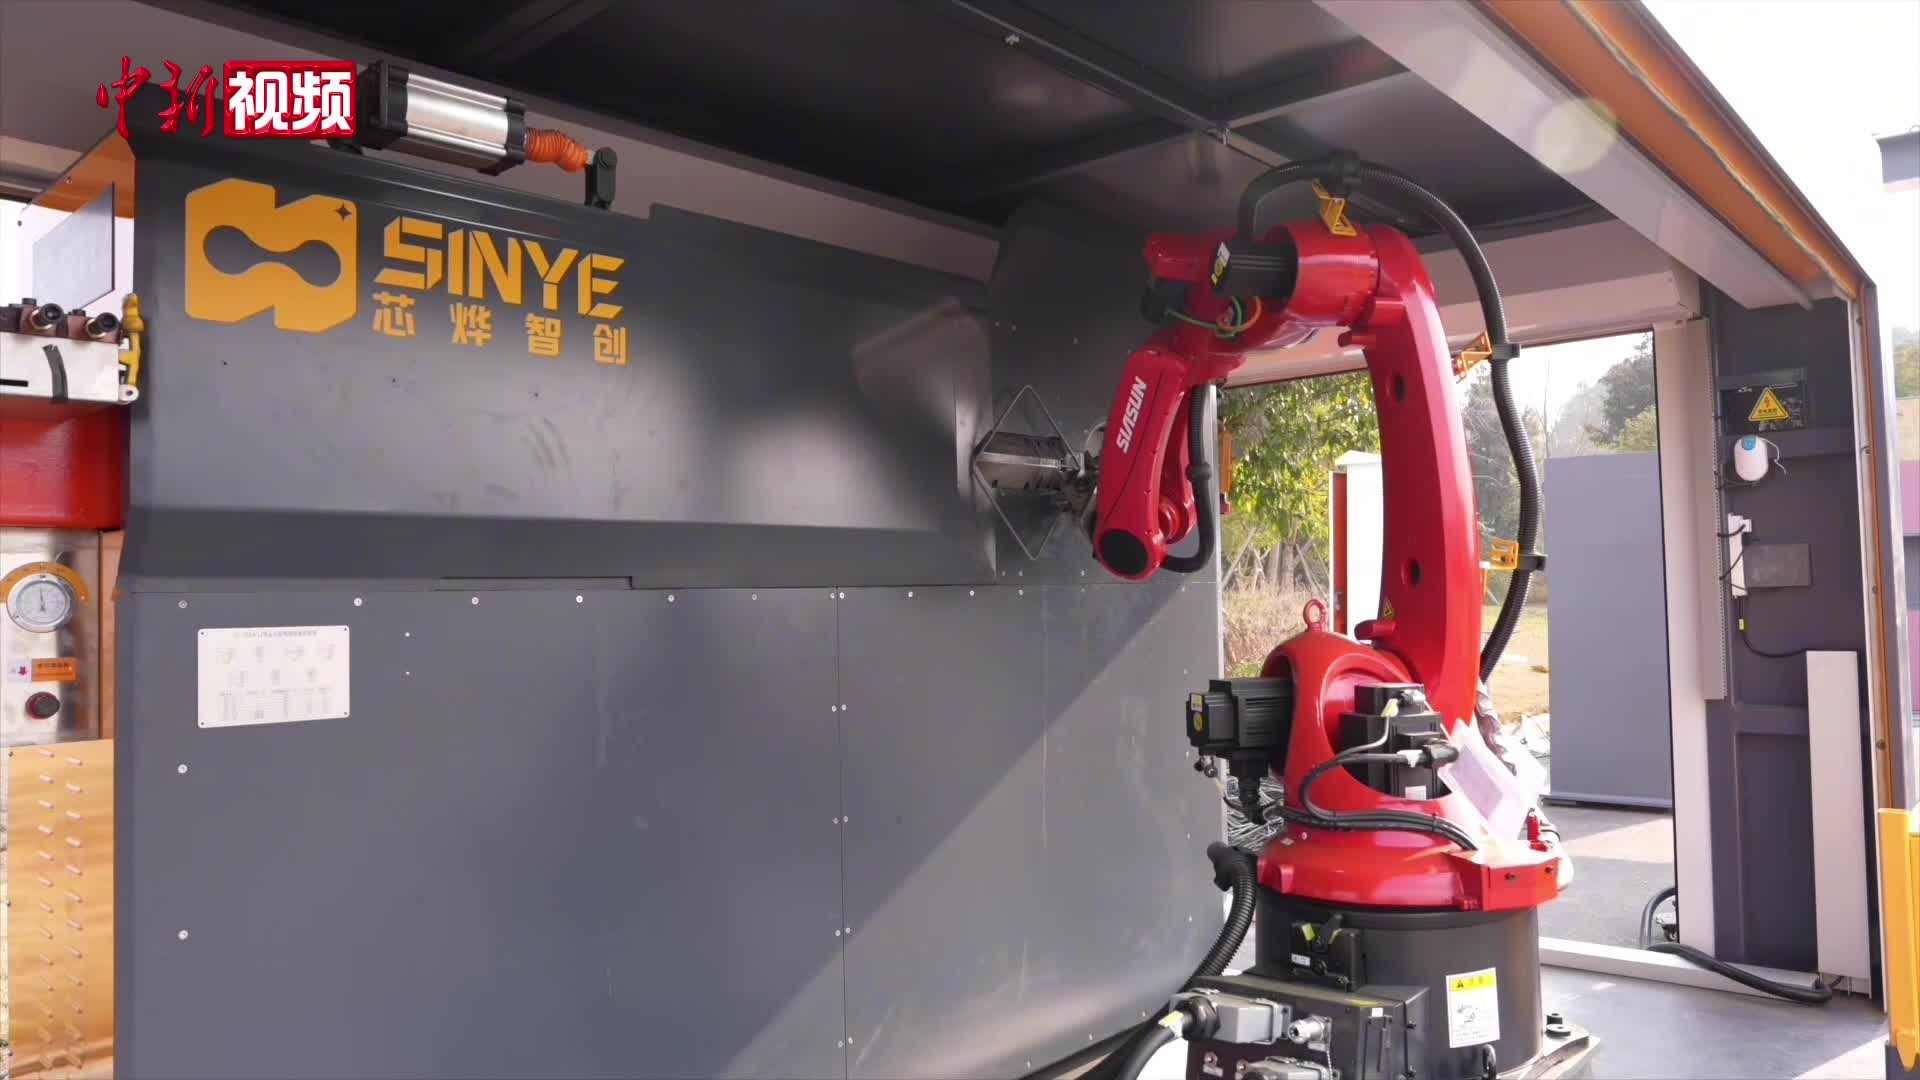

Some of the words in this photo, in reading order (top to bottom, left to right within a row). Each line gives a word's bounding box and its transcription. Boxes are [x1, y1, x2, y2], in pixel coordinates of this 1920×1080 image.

[374, 216, 625, 319] SINYE
[373, 291, 628, 367] 芯烨智创
[1116, 375, 1147, 454] SIASUN
